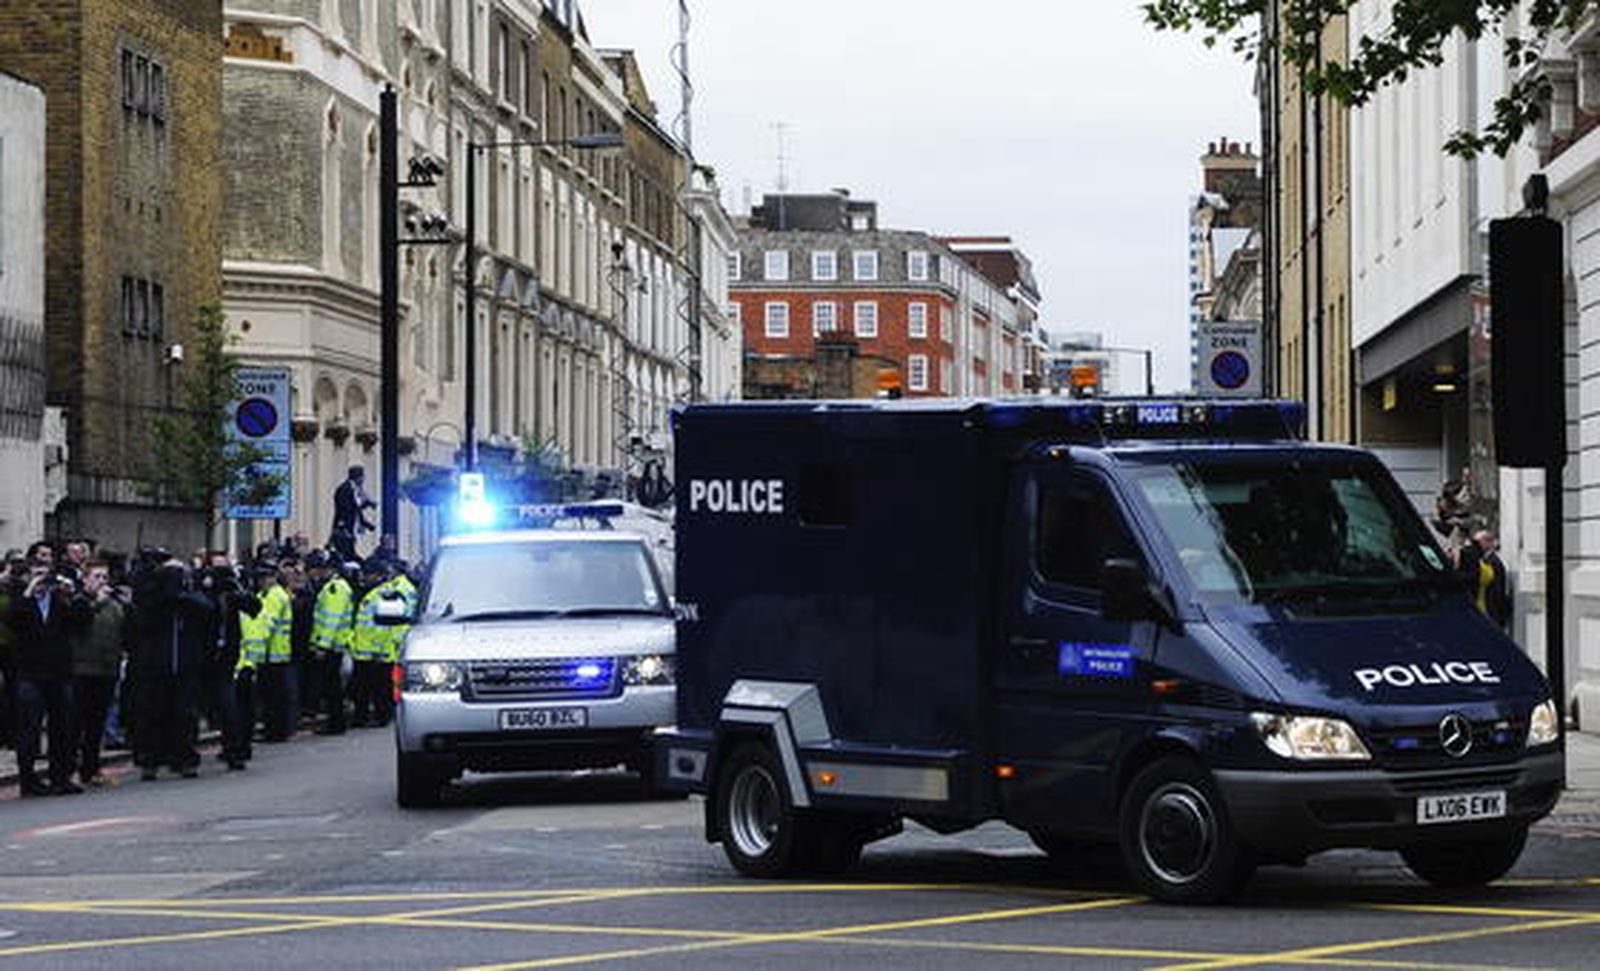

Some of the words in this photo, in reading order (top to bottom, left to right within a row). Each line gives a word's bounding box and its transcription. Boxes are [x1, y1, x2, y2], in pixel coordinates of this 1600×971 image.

[1211, 336, 1247, 349] ZONE
[1138, 407, 1179, 422] POLICE
[690, 479, 784, 513] POLICE
[1354, 661, 1501, 691] POLICE
[1425, 798, 1467, 819] LX06
